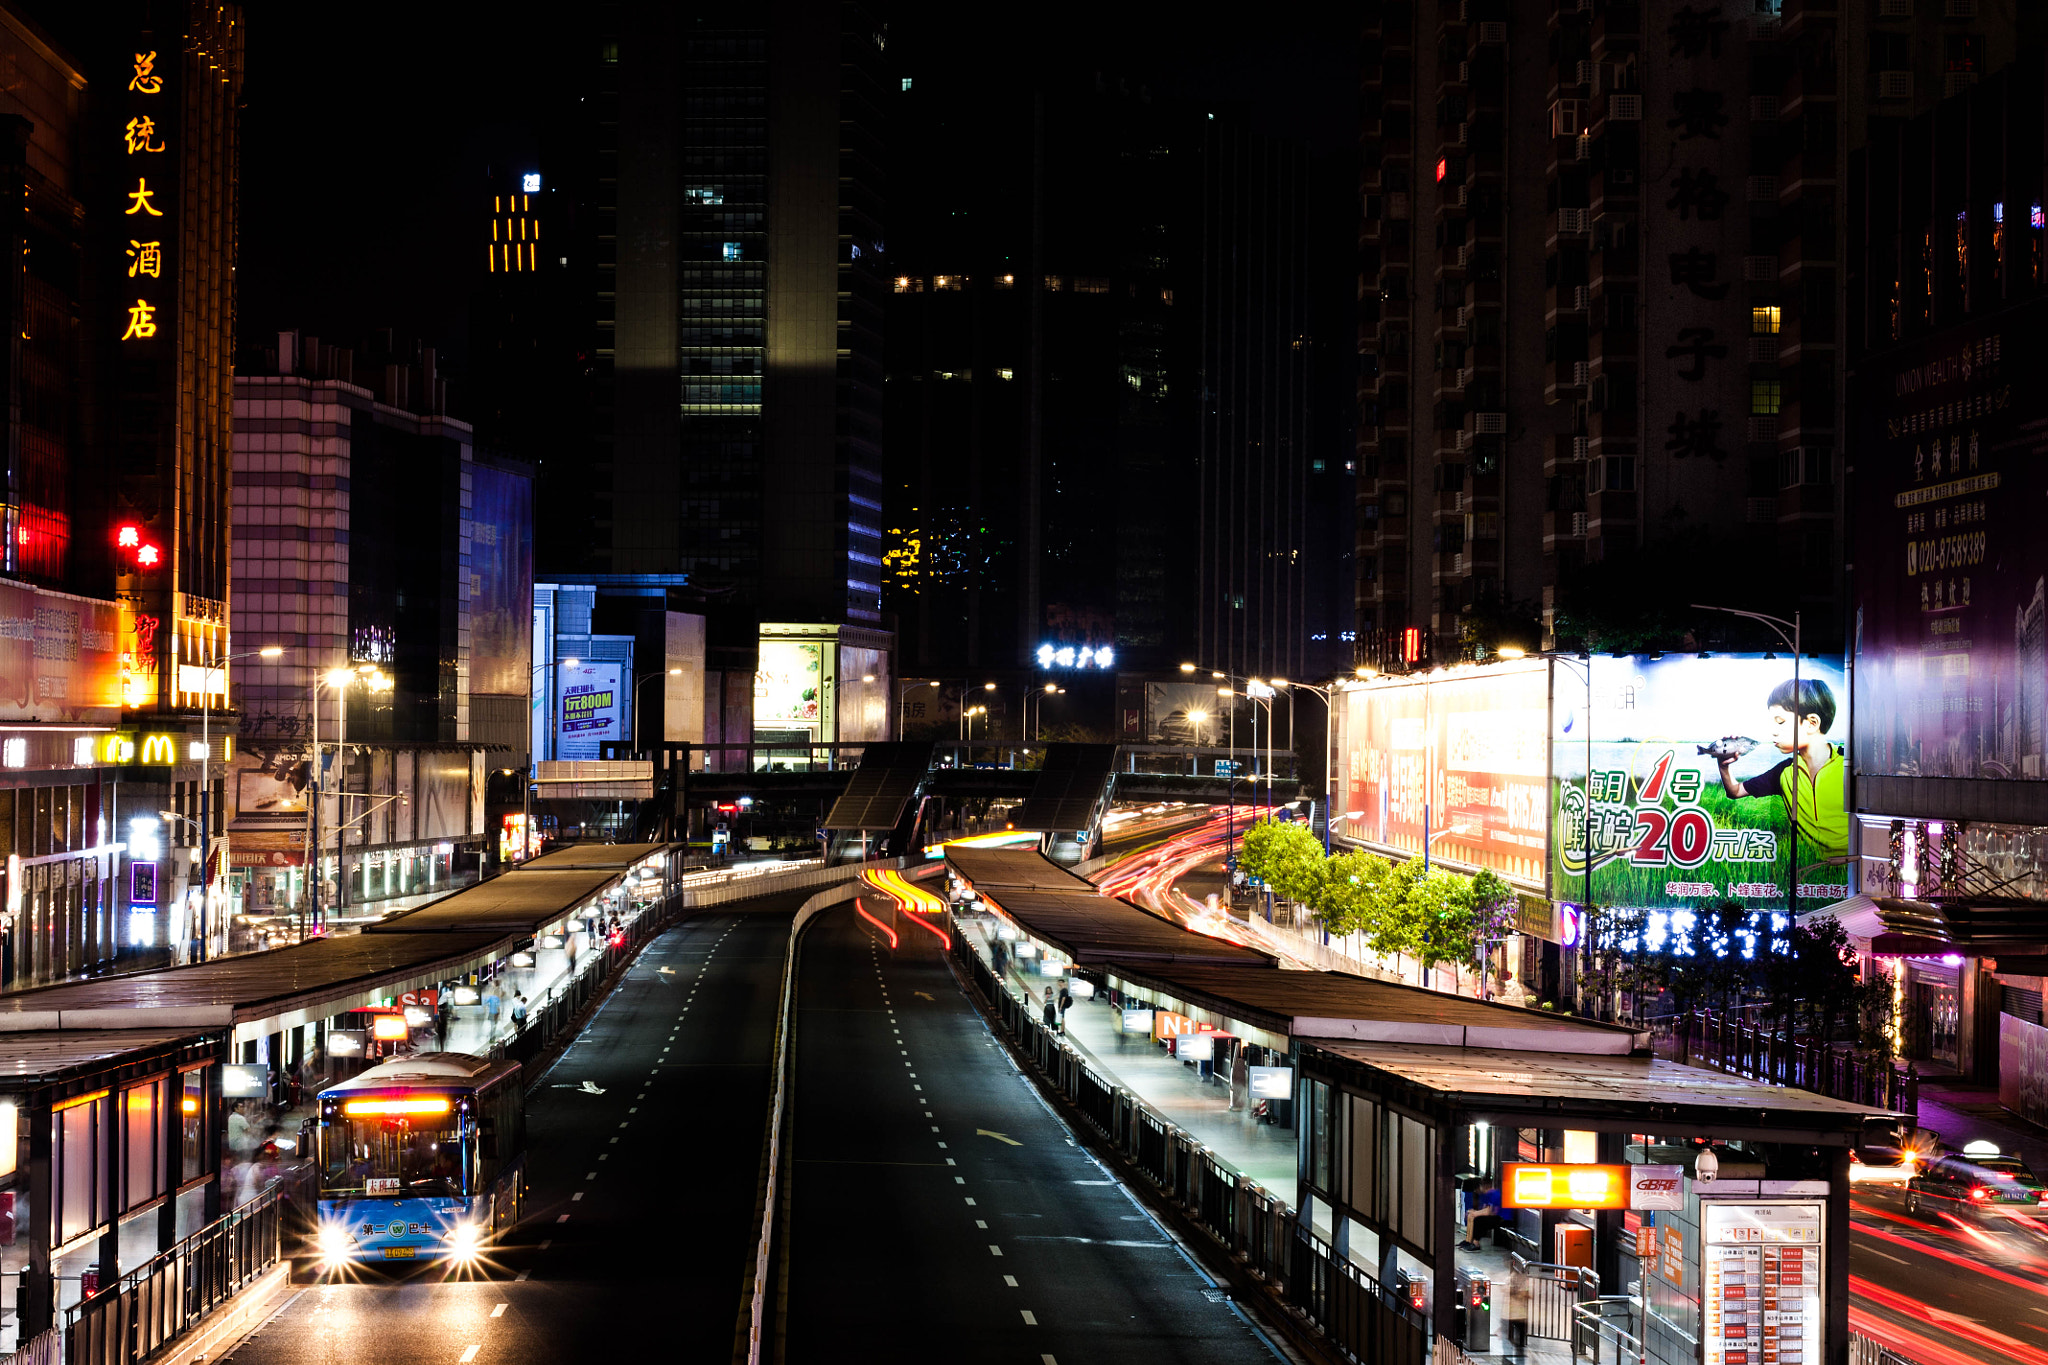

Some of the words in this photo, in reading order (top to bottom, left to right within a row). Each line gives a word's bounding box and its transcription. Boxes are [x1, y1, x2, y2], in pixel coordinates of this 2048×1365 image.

[121, 50, 165, 341] 总统大酒店
[1666, 5, 1729, 459] 新赛格电子城
[1895, 366, 1922, 398] UNION
[1919, 530, 1987, 573] 020-87589389
[564, 692, 612, 712] 1元800M
[897, 701, 926, 719] 两房
[1162, 1015, 1193, 1036] N1
[369, 1178, 399, 1194] 末班车
[362, 1223, 386, 1236] 第二
[408, 1222, 432, 1235] 巴士
